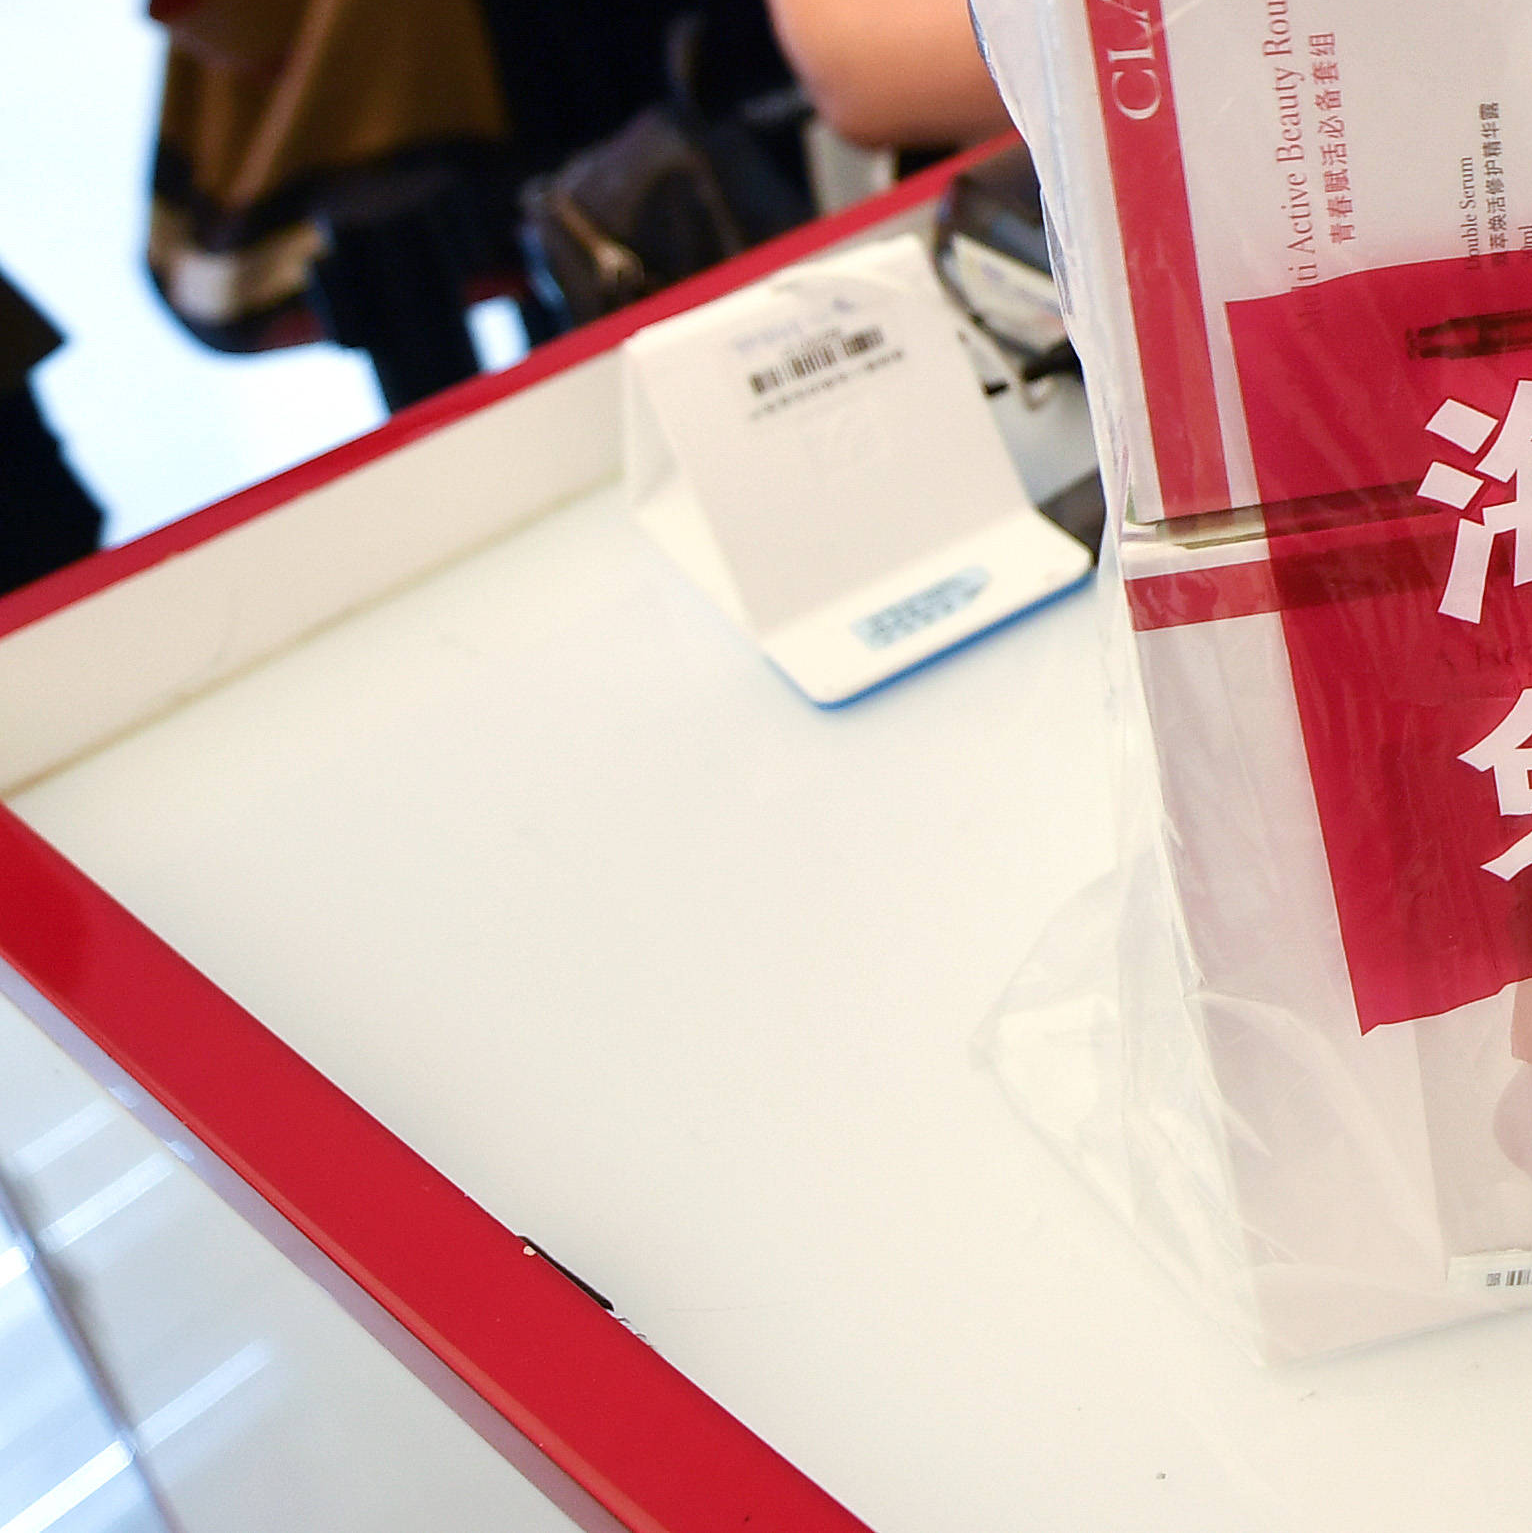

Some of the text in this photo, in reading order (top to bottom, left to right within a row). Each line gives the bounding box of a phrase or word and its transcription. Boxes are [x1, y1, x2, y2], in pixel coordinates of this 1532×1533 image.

[1272, 66, 1306, 164] Beauty
[1308, 32, 1357, 245] 青春赋活必备套组
[1281, 172, 1316, 254] Active
[1459, 157, 1478, 209] Serum
[1479, 102, 1508, 267] 萃焕活修护精华露
